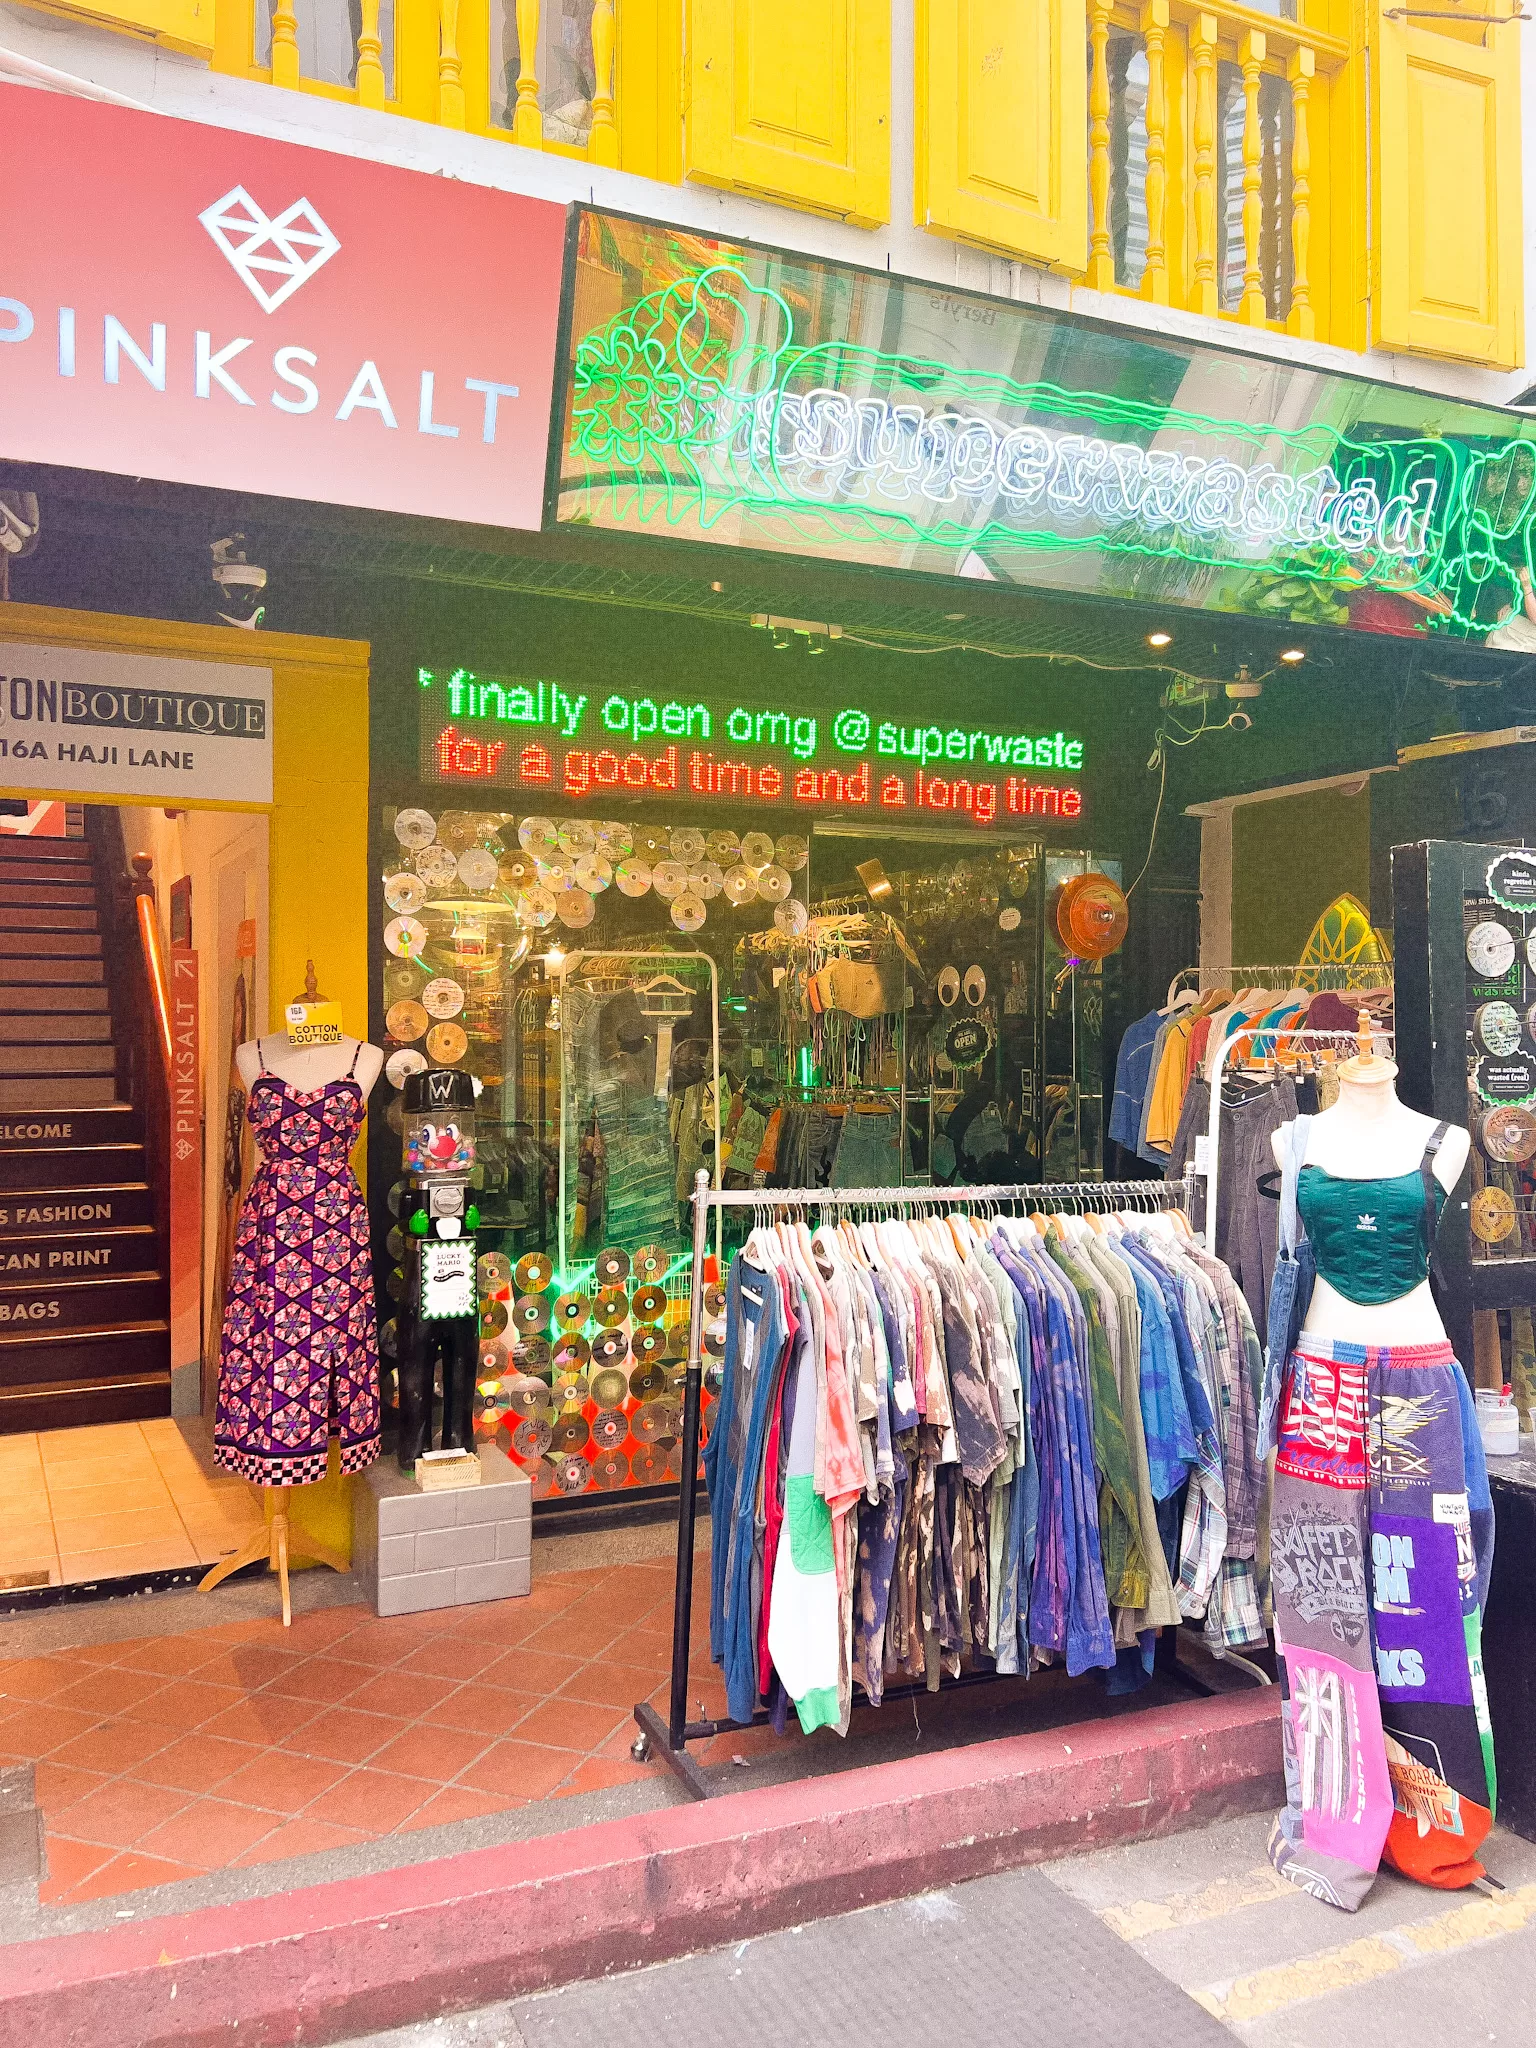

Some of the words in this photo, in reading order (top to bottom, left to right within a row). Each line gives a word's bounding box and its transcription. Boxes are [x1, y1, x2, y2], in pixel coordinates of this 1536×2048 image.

[793, 386, 1438, 558] superwasted
[65, 688, 265, 735] BOUTIQUE
[448, 667, 588, 737] finally
[602, 693, 711, 741] open
[726, 706, 817, 759] omg
[58, 743, 119, 765] HAJI
[129, 747, 195, 771] LANE
[436, 725, 504, 776] for
[520, 743, 552, 779] a
[563, 745, 678, 796] good
[688, 750, 783, 799] time
[795, 762, 871, 804] and
[881, 773, 907, 806] a
[915, 769, 998, 823] long
[1006, 776, 1082, 818] time
[1503, 878, 1532, 887] regretted
[1511, 869, 1530, 878] kinda
[288, 1032, 343, 1044] BOUTIQUE
[295, 1024, 338, 1035] COTTON
[954, 1034, 976, 1048] OPEN
[175, 997, 196, 1134] PINKSALT
[1502, 1066, 1528, 1075] actually
[428, 1070, 455, 1099] W
[1487, 1073, 1510, 1081] wasted
[1511, 1073, 1530, 1082] (real)
[16, 1203, 112, 1224] FASHION
[48, 1248, 112, 1268] PRINT
[437, 1259, 461, 1267] MARIO
[0, 1301, 60, 1321] BAGS
[1374, 1565, 1411, 1604] M
[1377, 1648, 1427, 1688] KS
[1401, 1767, 1448, 1789] BOARD
